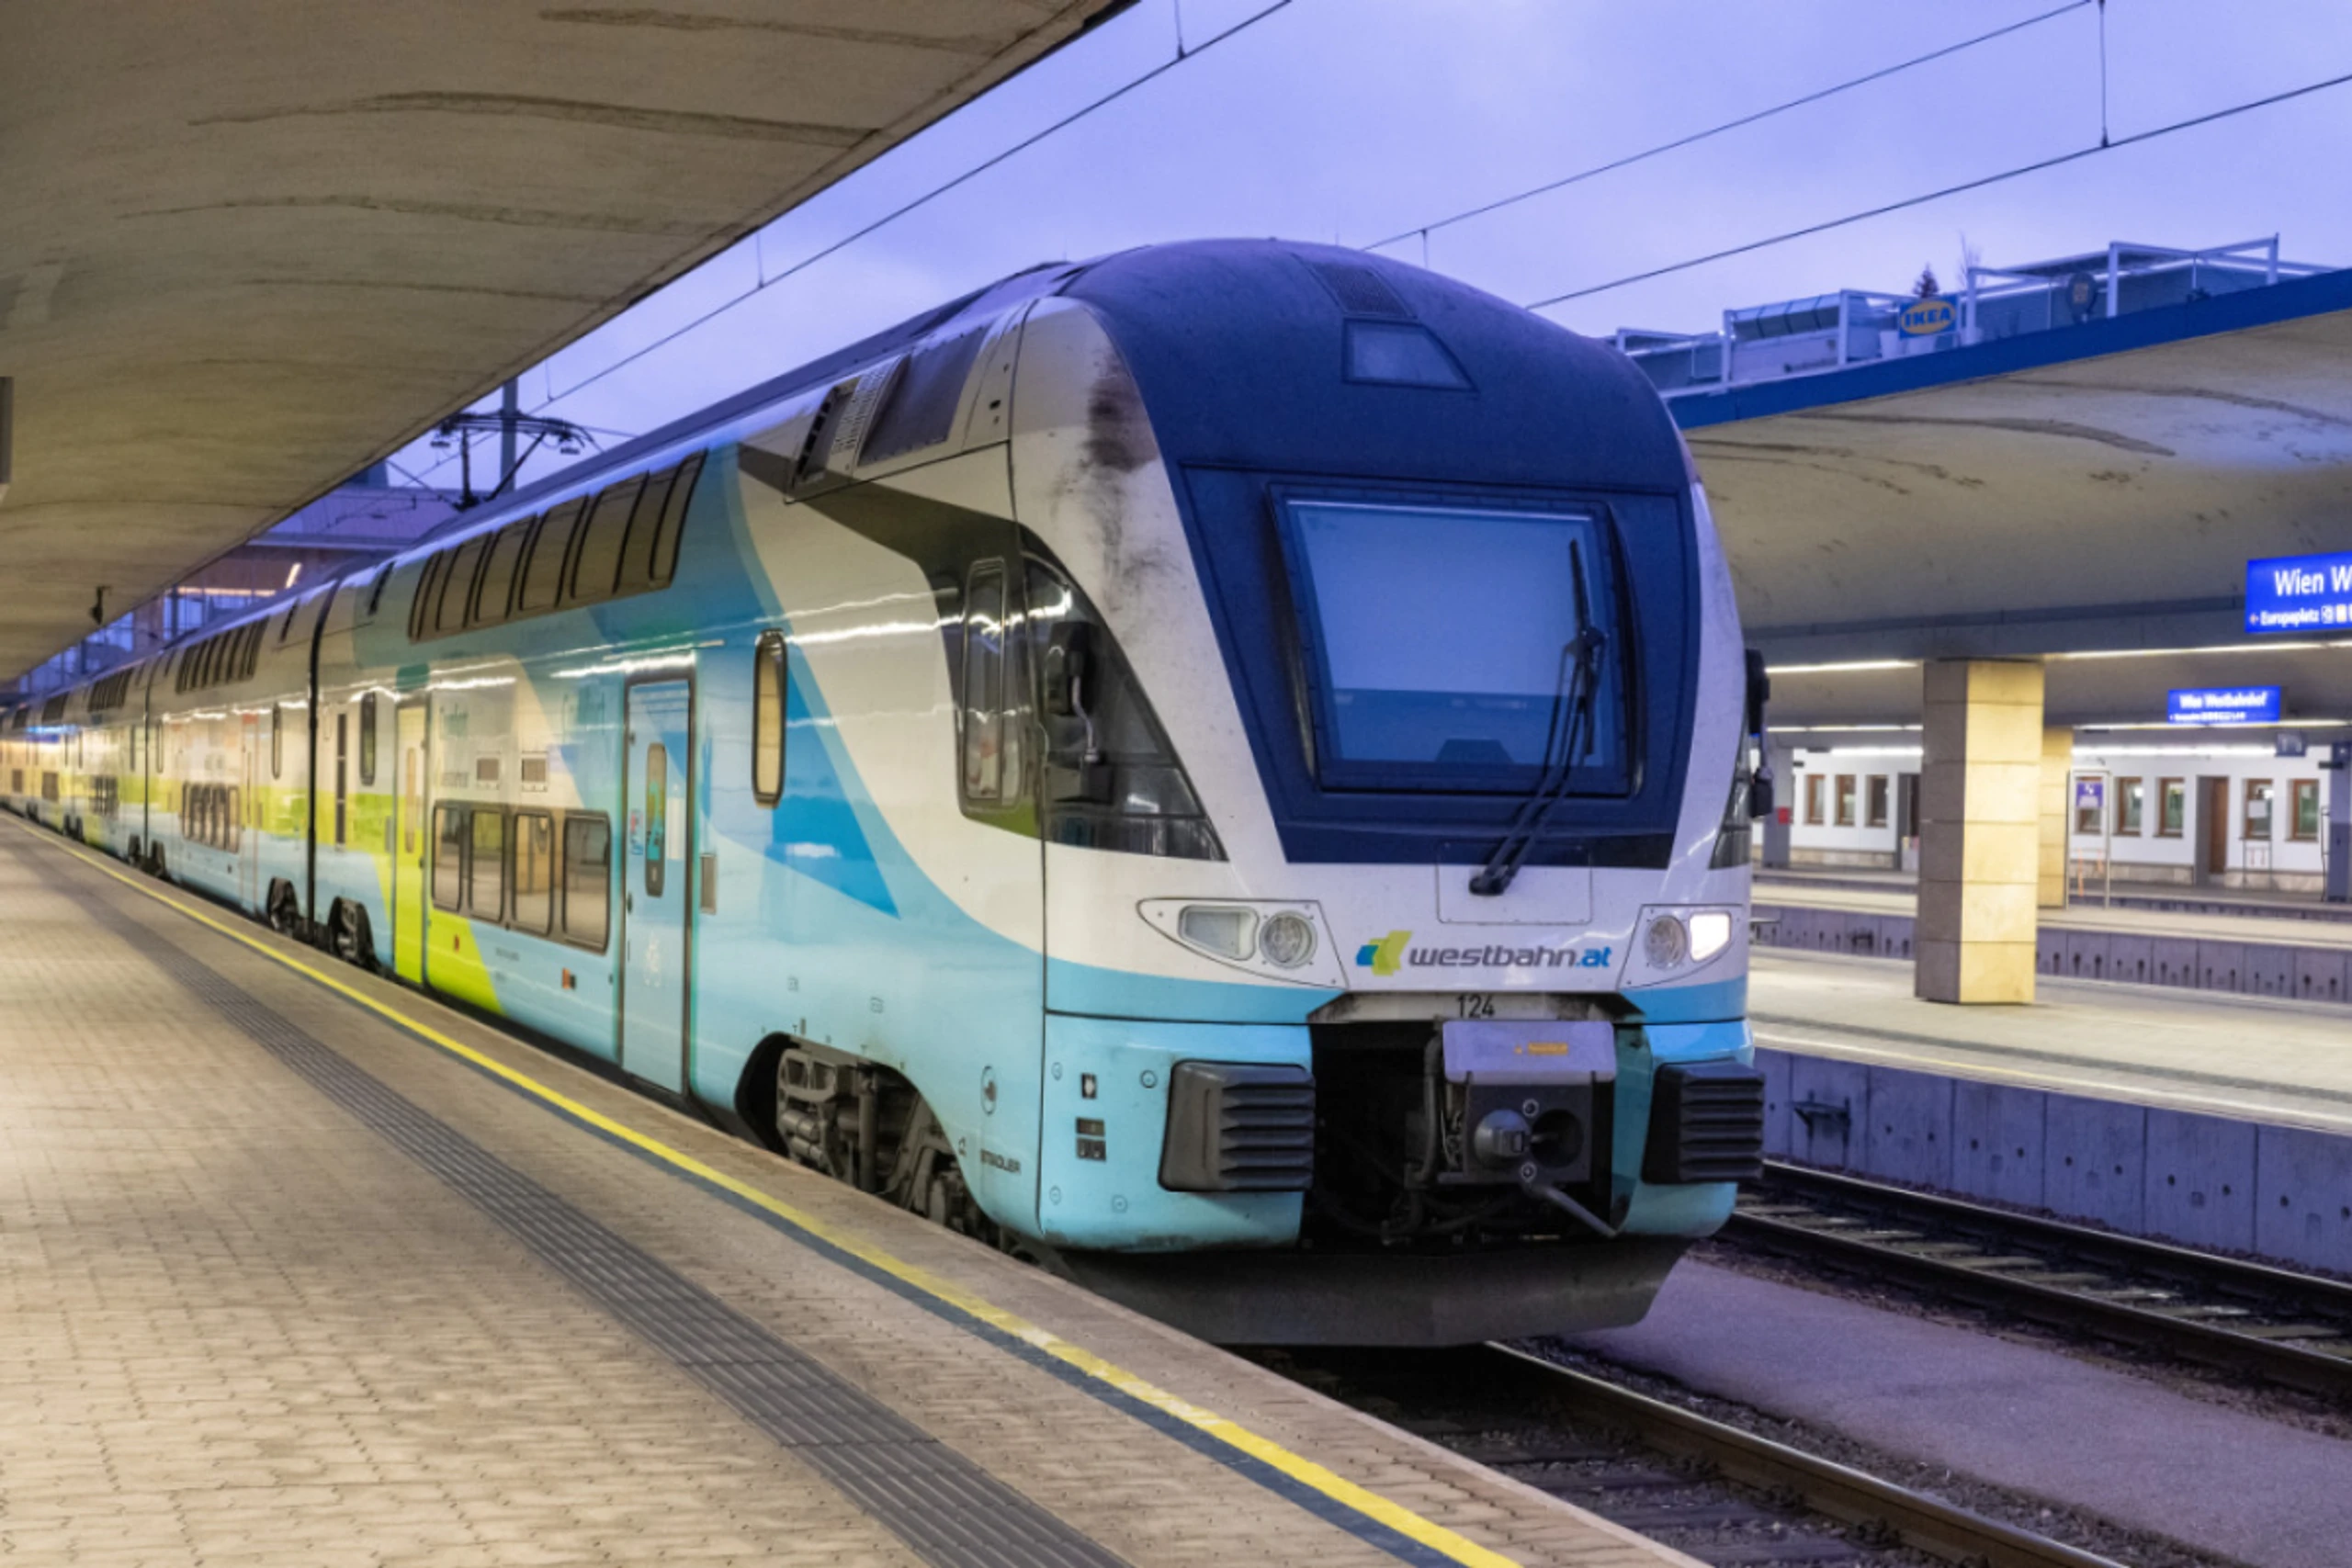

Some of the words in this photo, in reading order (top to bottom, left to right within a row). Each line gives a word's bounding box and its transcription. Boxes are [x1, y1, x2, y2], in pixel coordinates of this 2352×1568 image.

[1905, 307, 1951, 327] IKEA
[2274, 568, 2324, 597] Wien
[1408, 944, 1612, 968] westbahn.at
[1457, 995, 1496, 1019] 124
